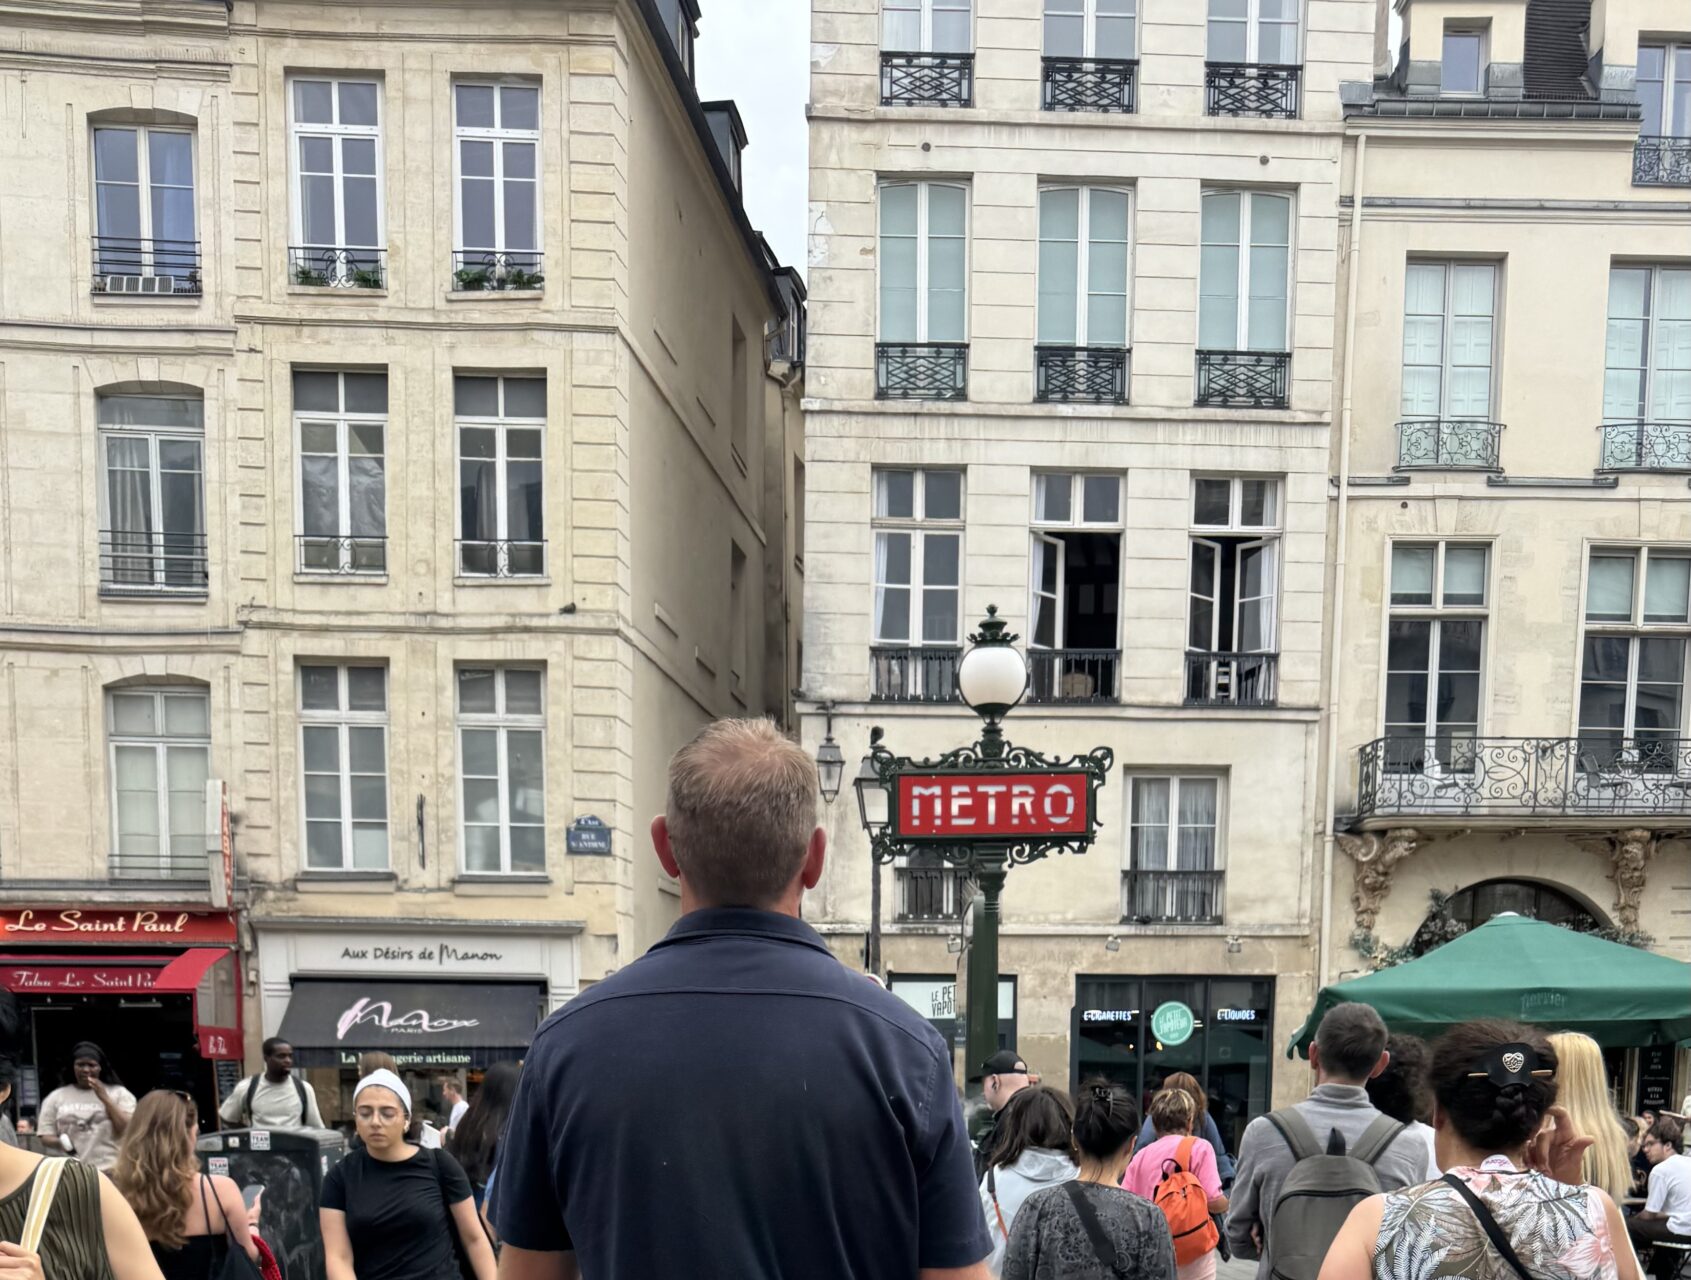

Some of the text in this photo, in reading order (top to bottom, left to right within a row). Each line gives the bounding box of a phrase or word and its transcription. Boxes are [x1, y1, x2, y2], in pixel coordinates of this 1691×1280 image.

[912, 784, 1075, 826] METRO
[5, 909, 188, 932] Le Saint Paul
[341, 943, 502, 965] Aux Désirs de Manon
[91, 972, 132, 987] Saint
[931, 985, 956, 1002] LE PET
[931, 1001, 956, 1017] VAPOT
[341, 1052, 356, 1064] La
[425, 1052, 471, 1064] artisane
